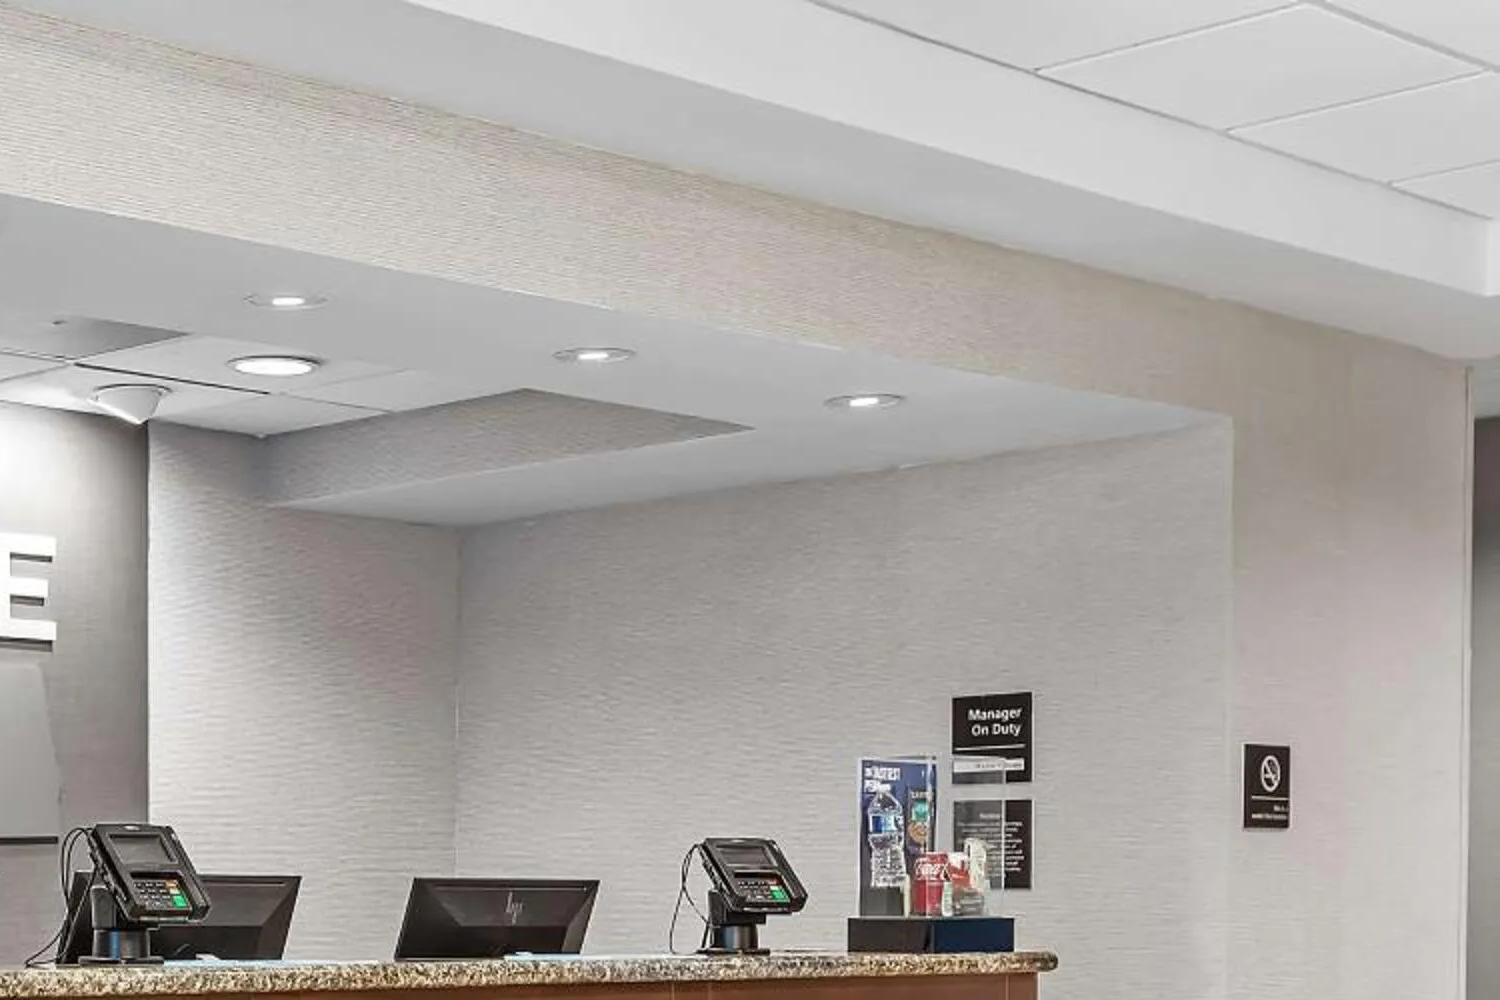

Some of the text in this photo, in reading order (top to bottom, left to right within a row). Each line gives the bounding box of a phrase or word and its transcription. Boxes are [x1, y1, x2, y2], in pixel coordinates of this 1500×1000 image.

[968, 707, 1023, 722] Manager
[971, 723, 1022, 737] On Duty
